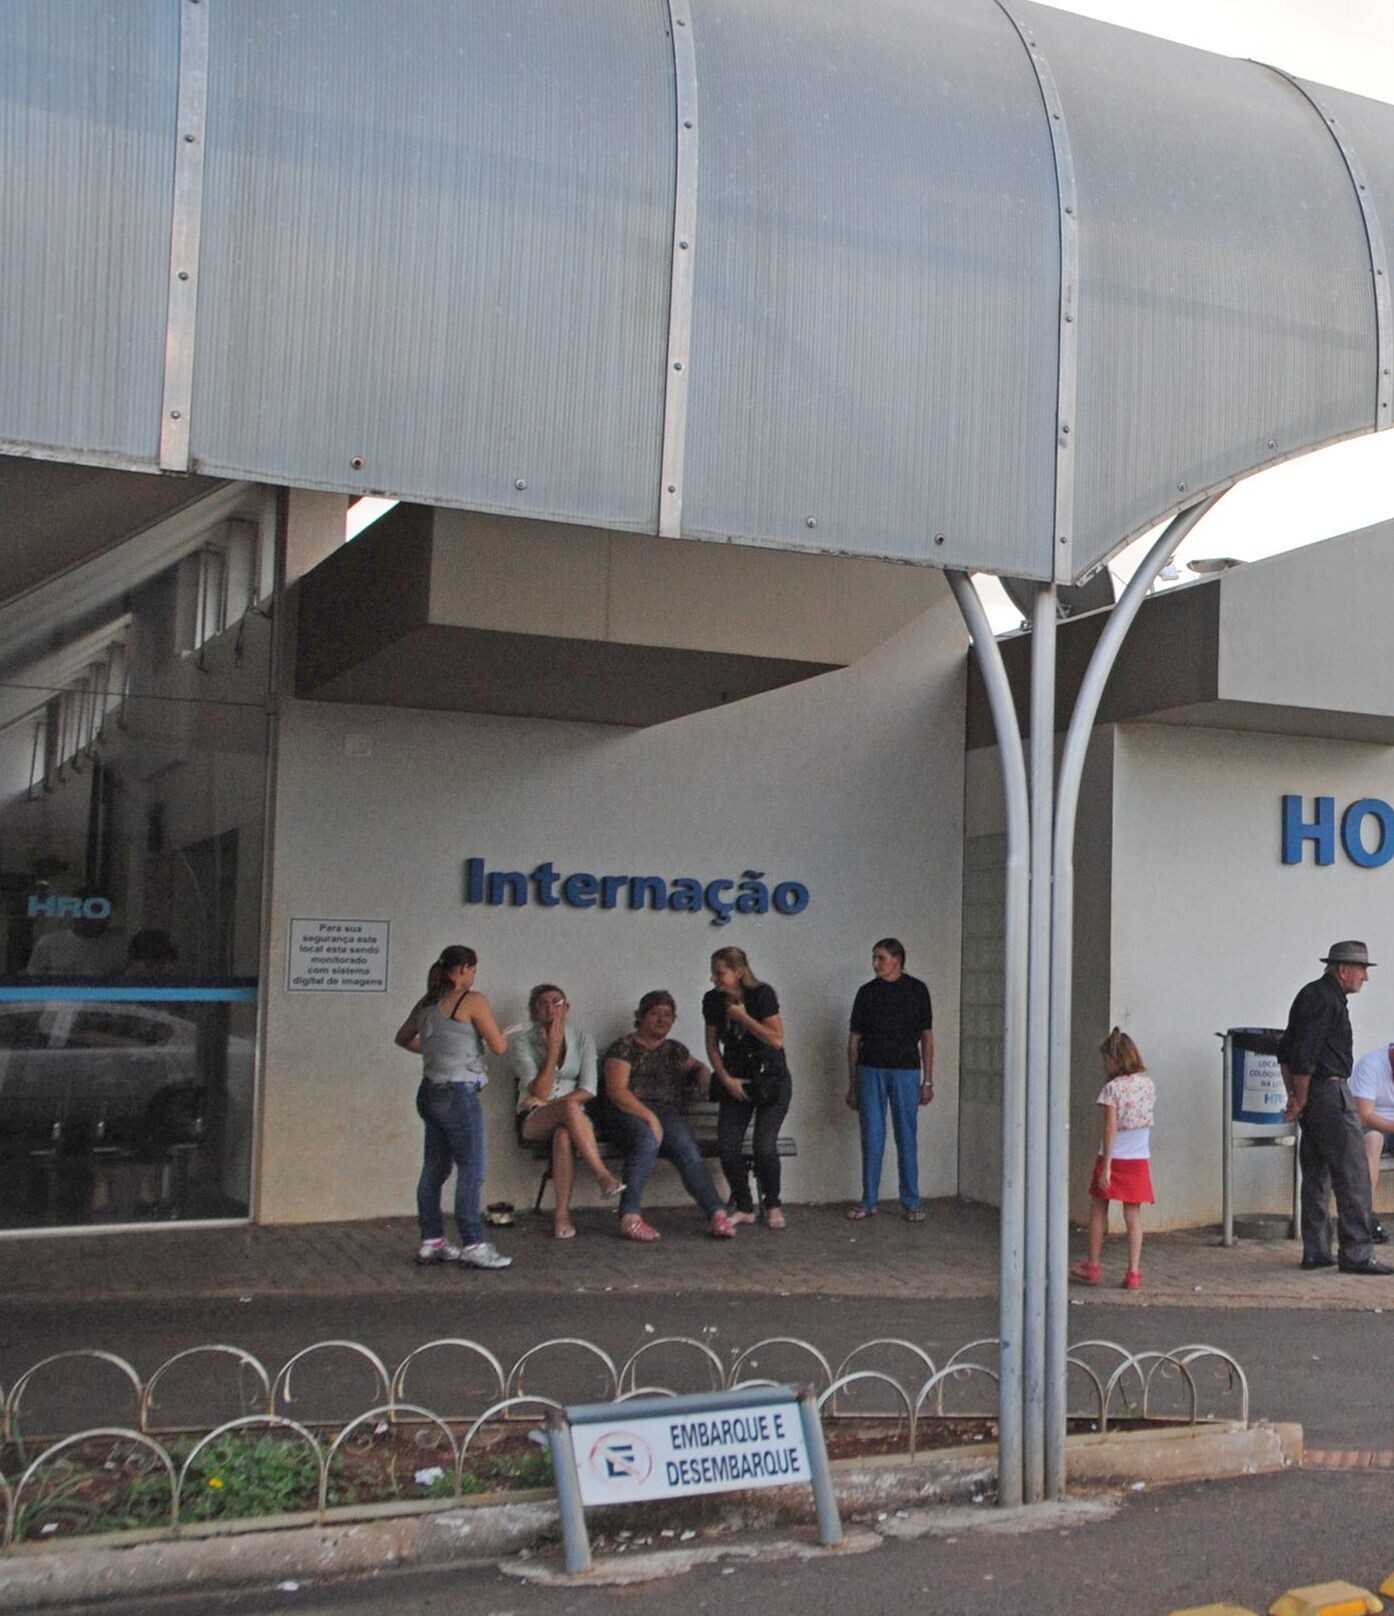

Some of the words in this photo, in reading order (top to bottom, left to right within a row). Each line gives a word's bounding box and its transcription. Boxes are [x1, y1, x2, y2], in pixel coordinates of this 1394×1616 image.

[464, 858, 810, 926] Internação
[27, 895, 112, 919] HRO
[319, 923, 341, 932] Para
[344, 925, 362, 933] sua
[302, 935, 354, 944] segurança
[299, 945, 323, 953] local
[349, 946, 380, 955] sendo
[311, 956, 368, 965] monitorado
[331, 966, 370, 975] sistema
[292, 977, 324, 987] digital
[326, 977, 339, 985] de
[341, 978, 383, 988] imagens
[670, 1416, 770, 1450] EMBARQUE
[774, 1415, 786, 1440] E
[665, 1448, 801, 1487] DESEMBARQUE
